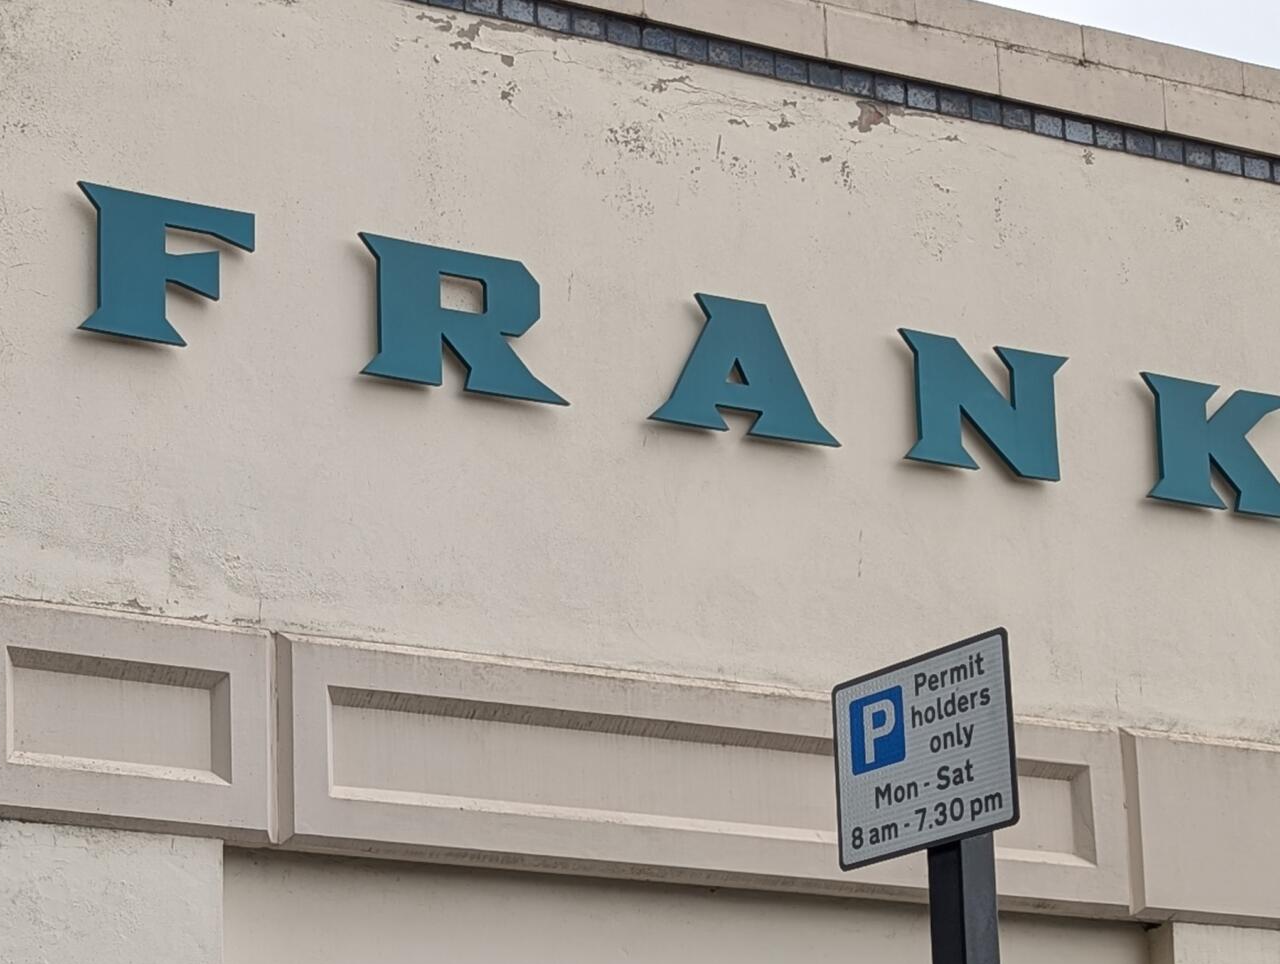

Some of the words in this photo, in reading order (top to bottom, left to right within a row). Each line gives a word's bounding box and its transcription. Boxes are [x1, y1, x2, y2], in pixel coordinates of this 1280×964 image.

[77, 180, 1280, 520] FRANK
[914, 652, 985, 697] Permit
[910, 687, 991, 728] holders
[862, 698, 896, 765] P
[929, 722, 975, 753] only
[874, 781, 919, 809] Mon
[936, 760, 974, 791] Sat
[915, 797, 964, 832] 7.30
[970, 791, 1003, 821] pm
